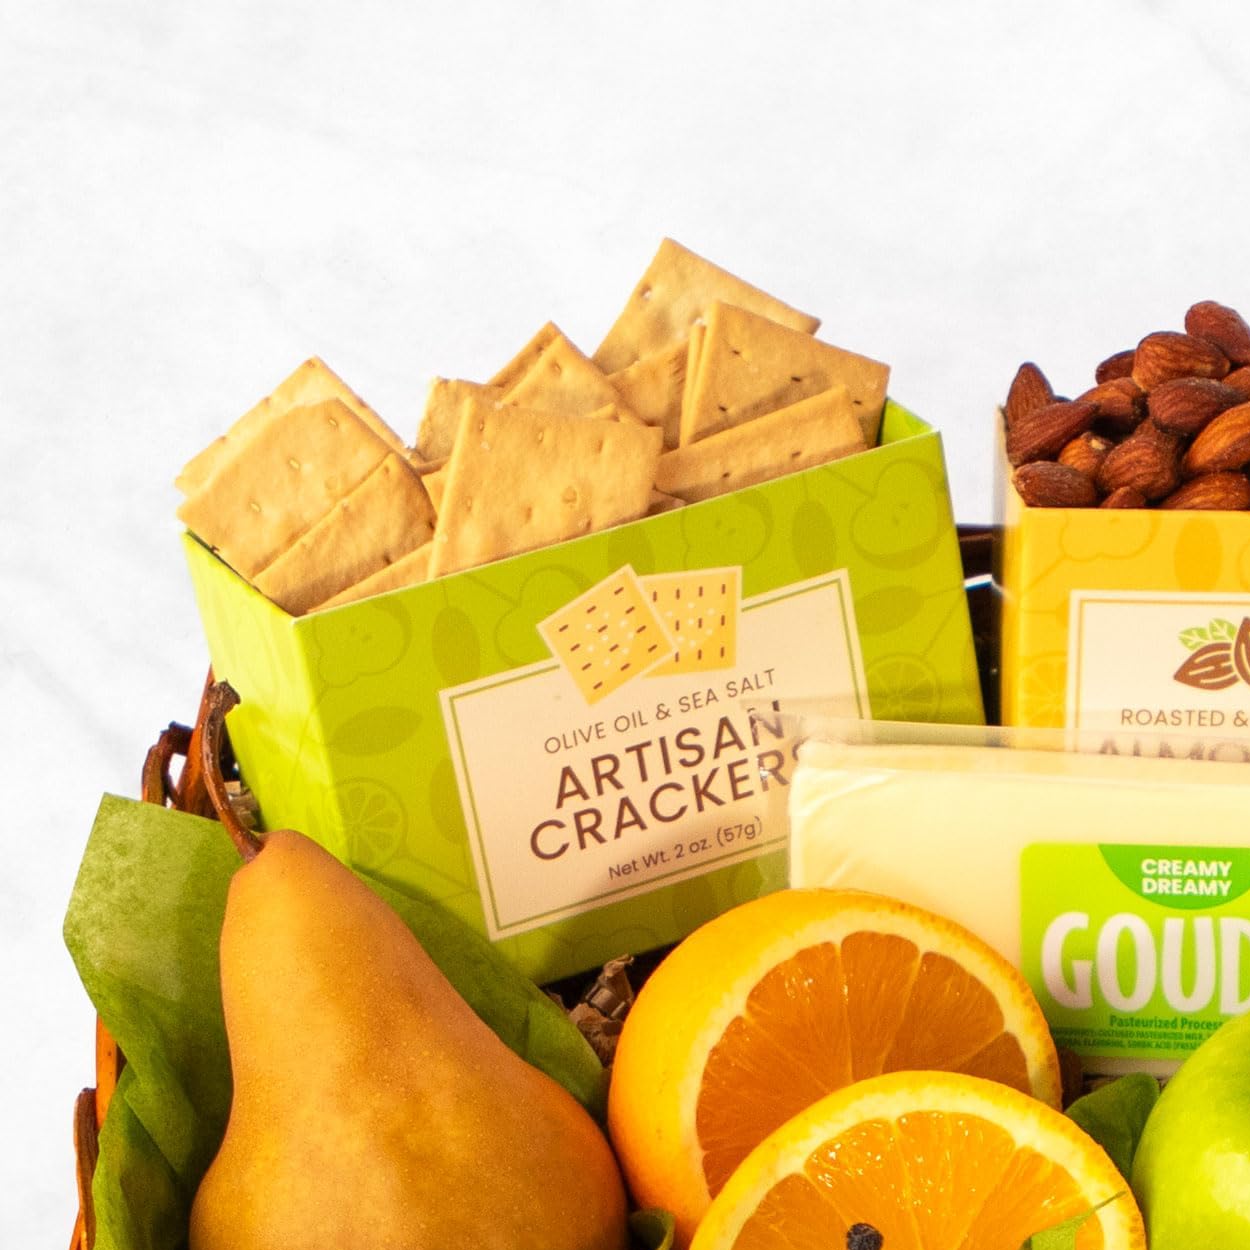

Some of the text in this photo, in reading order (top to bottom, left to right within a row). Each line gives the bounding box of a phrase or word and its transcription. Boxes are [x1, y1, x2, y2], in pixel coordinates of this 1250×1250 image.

[544, 668, 776, 754] OLIVE OIL & SEA SALT
[1121, 708, 1225, 727] ROASTED
[1233, 709, 1249, 727] &
[556, 700, 786, 809] ARTISAN
[608, 815, 763, 880] Net Wt. 2 oz. (57g)
[1140, 858, 1233, 878] CREAMY
[1141, 877, 1233, 897] DREAMY
[1110, 1015, 1178, 1030] Pasteurized
